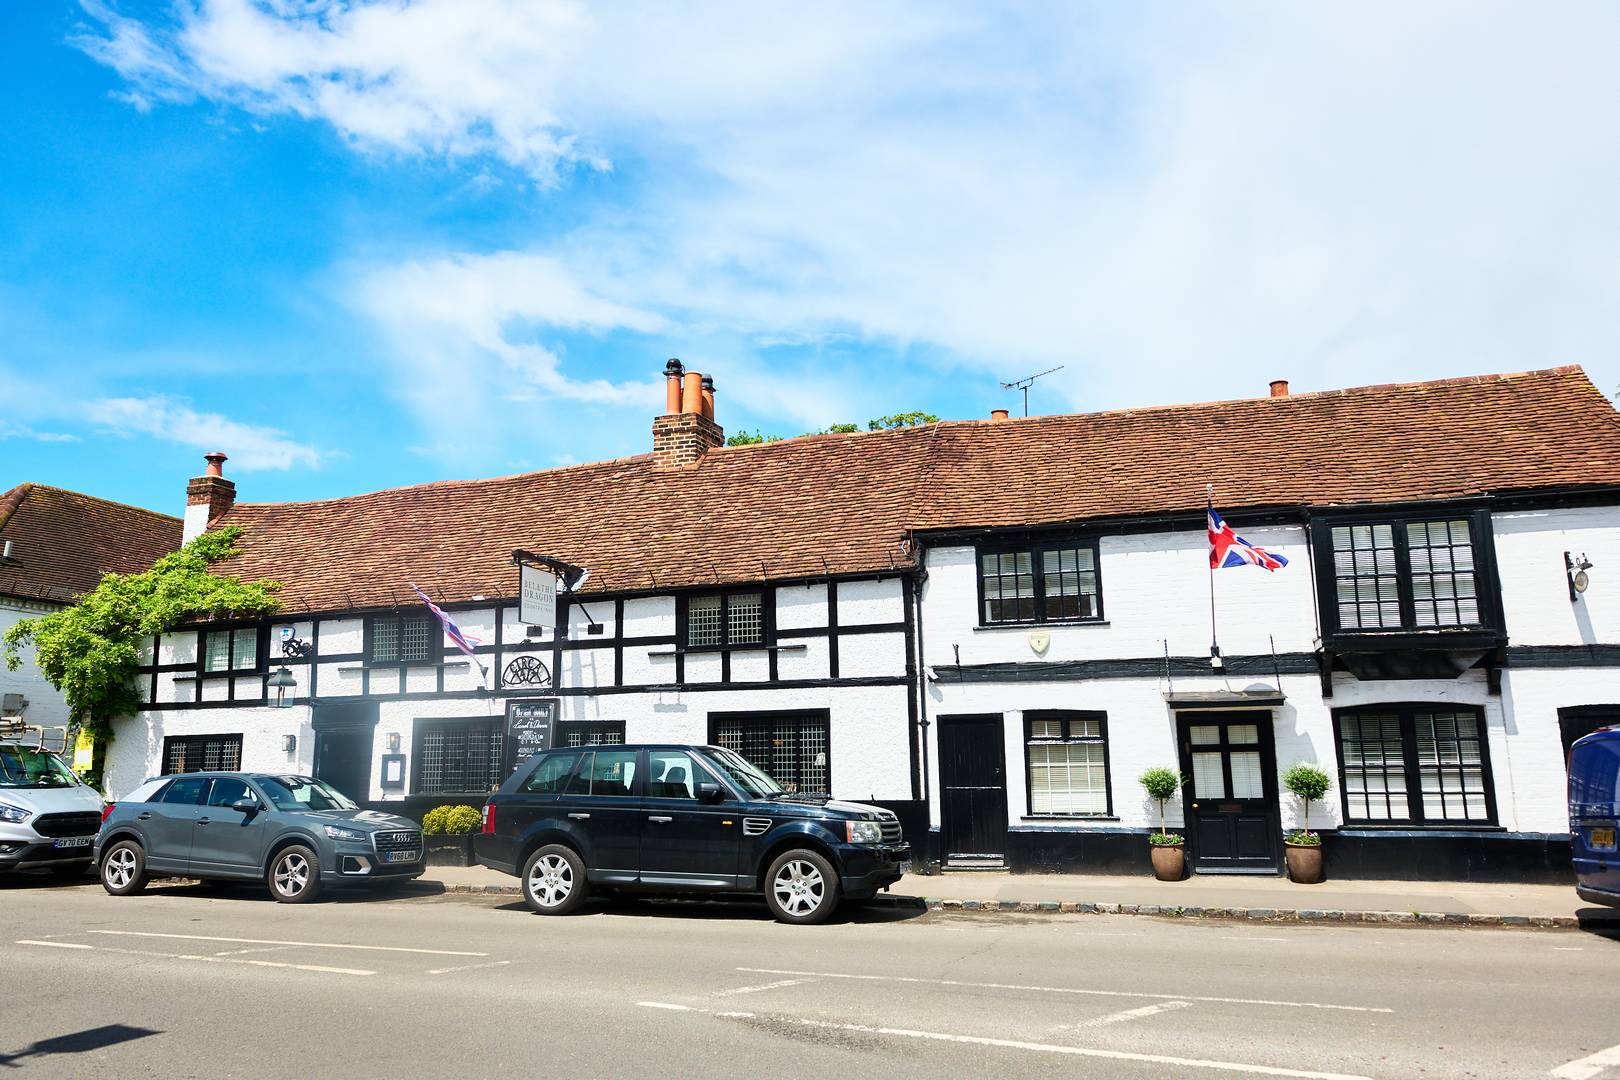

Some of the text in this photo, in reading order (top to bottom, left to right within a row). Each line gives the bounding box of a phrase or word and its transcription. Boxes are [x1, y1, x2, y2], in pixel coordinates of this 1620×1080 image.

[524, 580, 536, 590] BEL
[541, 584, 554, 594] THE
[524, 589, 554, 603] DRAGON
[510, 657, 541, 673] CIRCA
